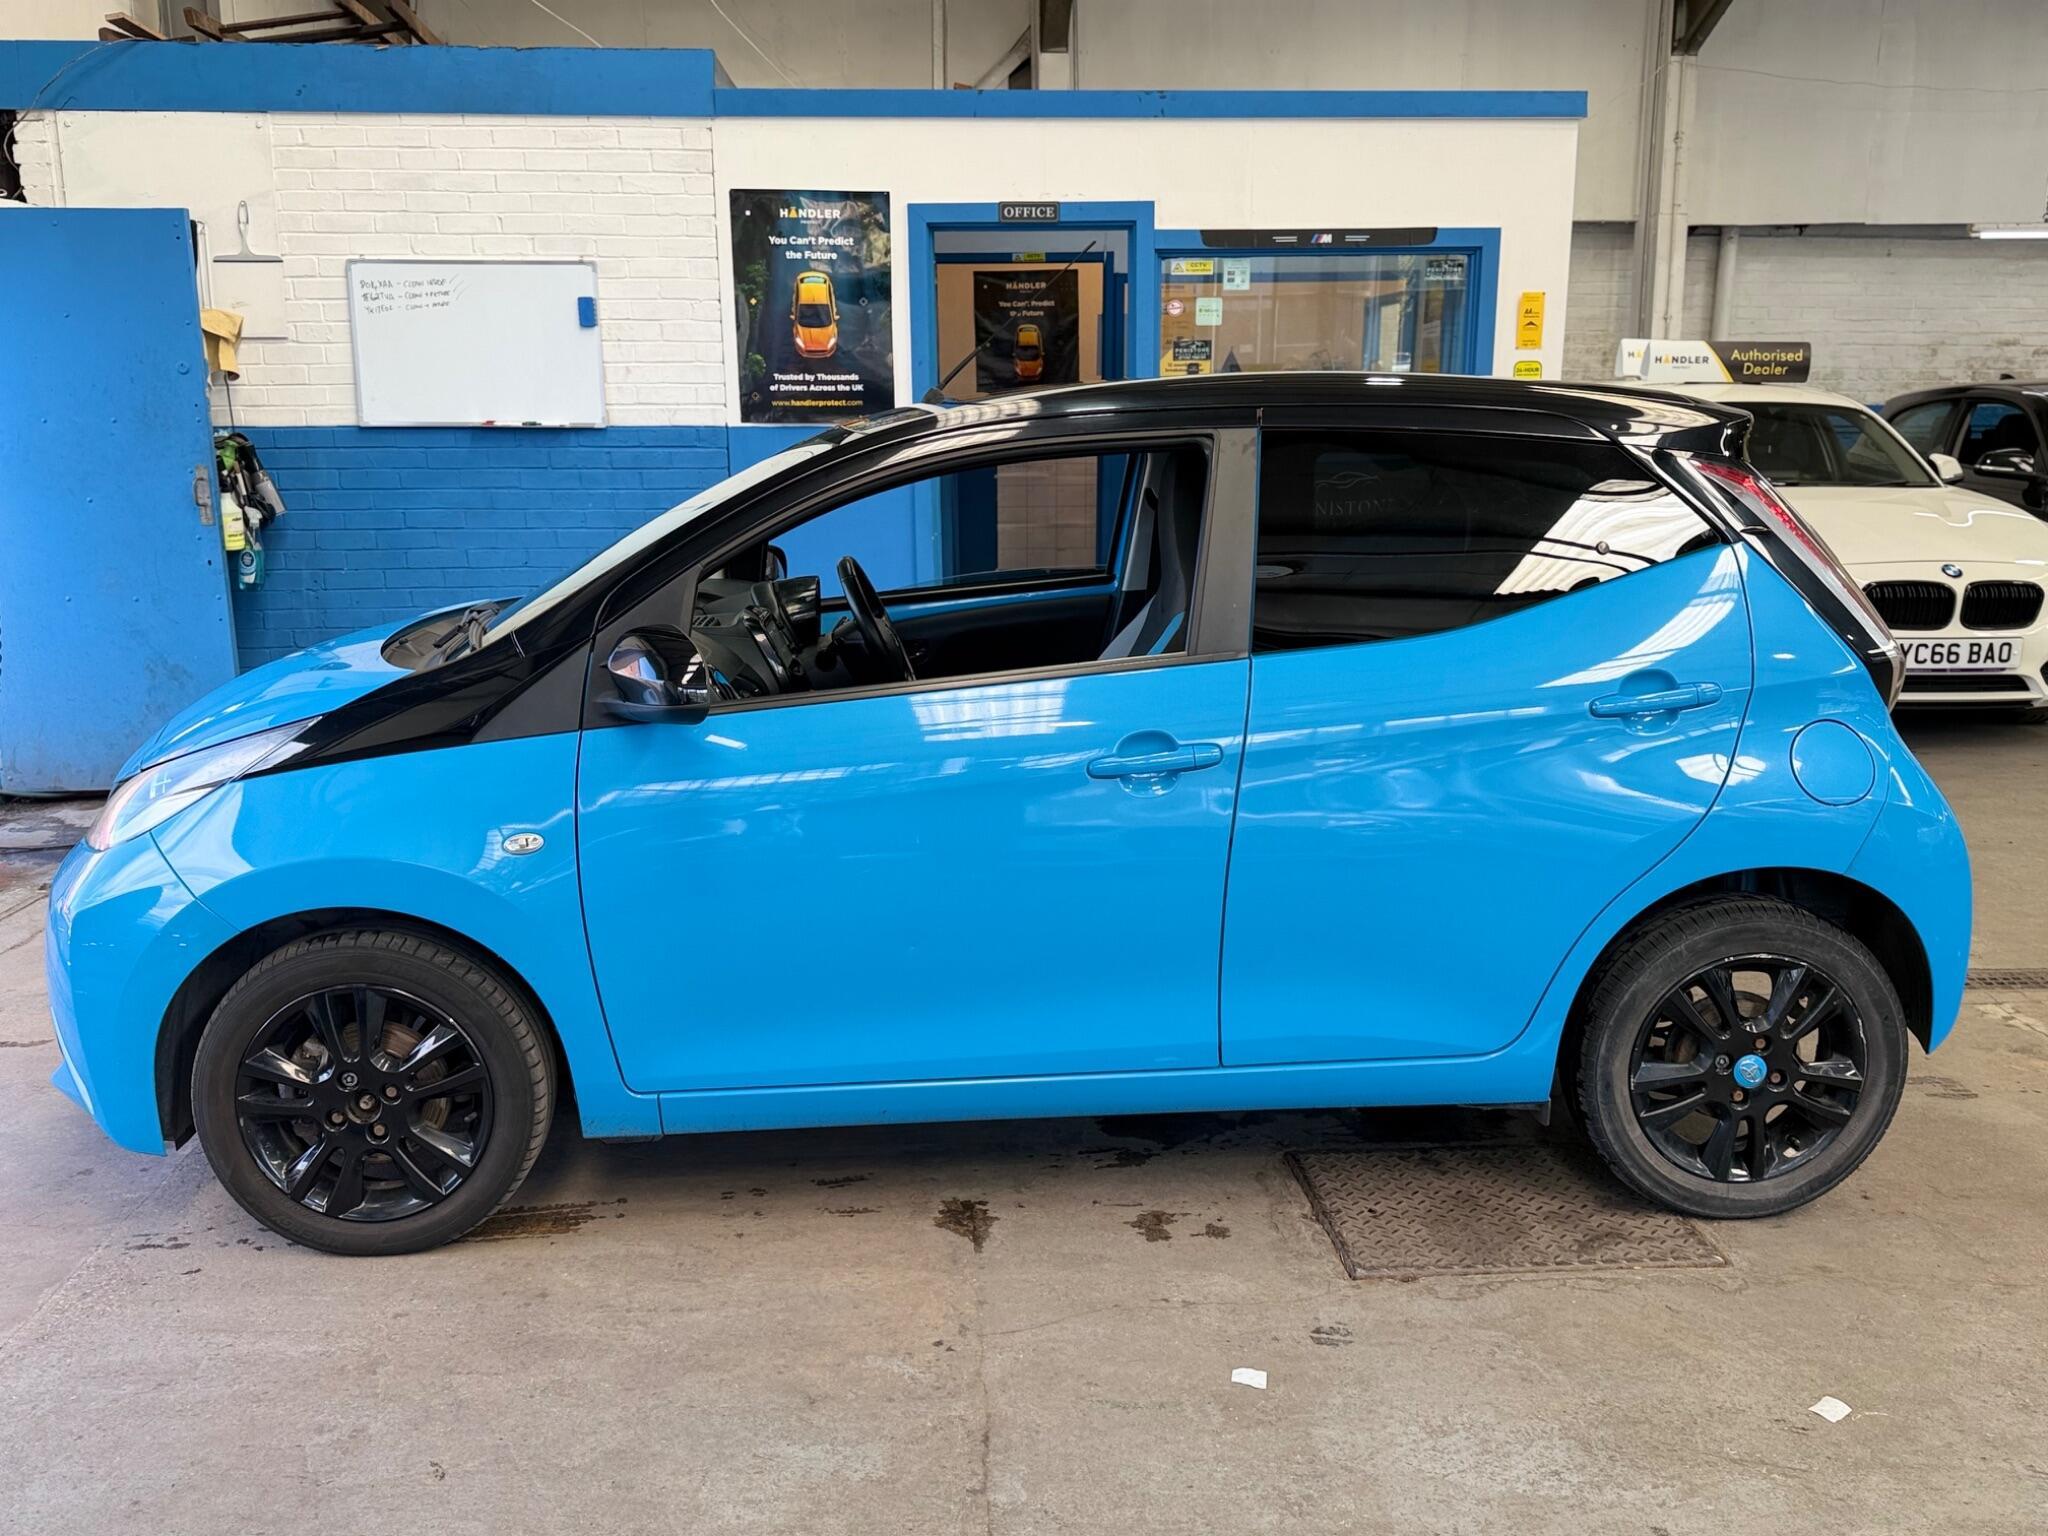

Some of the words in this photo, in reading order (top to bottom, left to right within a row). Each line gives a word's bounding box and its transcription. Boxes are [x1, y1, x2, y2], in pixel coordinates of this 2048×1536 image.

[1003, 206, 1055, 218] OFFICE
[768, 235, 787, 245] You
[789, 235, 817, 245] Can't
[818, 236, 855, 246] Predict
[785, 250, 802, 260] the
[804, 250, 838, 260] Future
[1730, 348, 1803, 361] Authorised
[1743, 362, 1789, 375] Dealer
[773, 373, 803, 381] Trusted
[804, 373, 815, 382] by
[816, 373, 860, 381] Thousands
[769, 383, 779, 391] of
[780, 383, 808, 391] Drivers
[771, 400, 864, 408] www.handlerprotect.com
[1900, 642, 1962, 665] YC66
